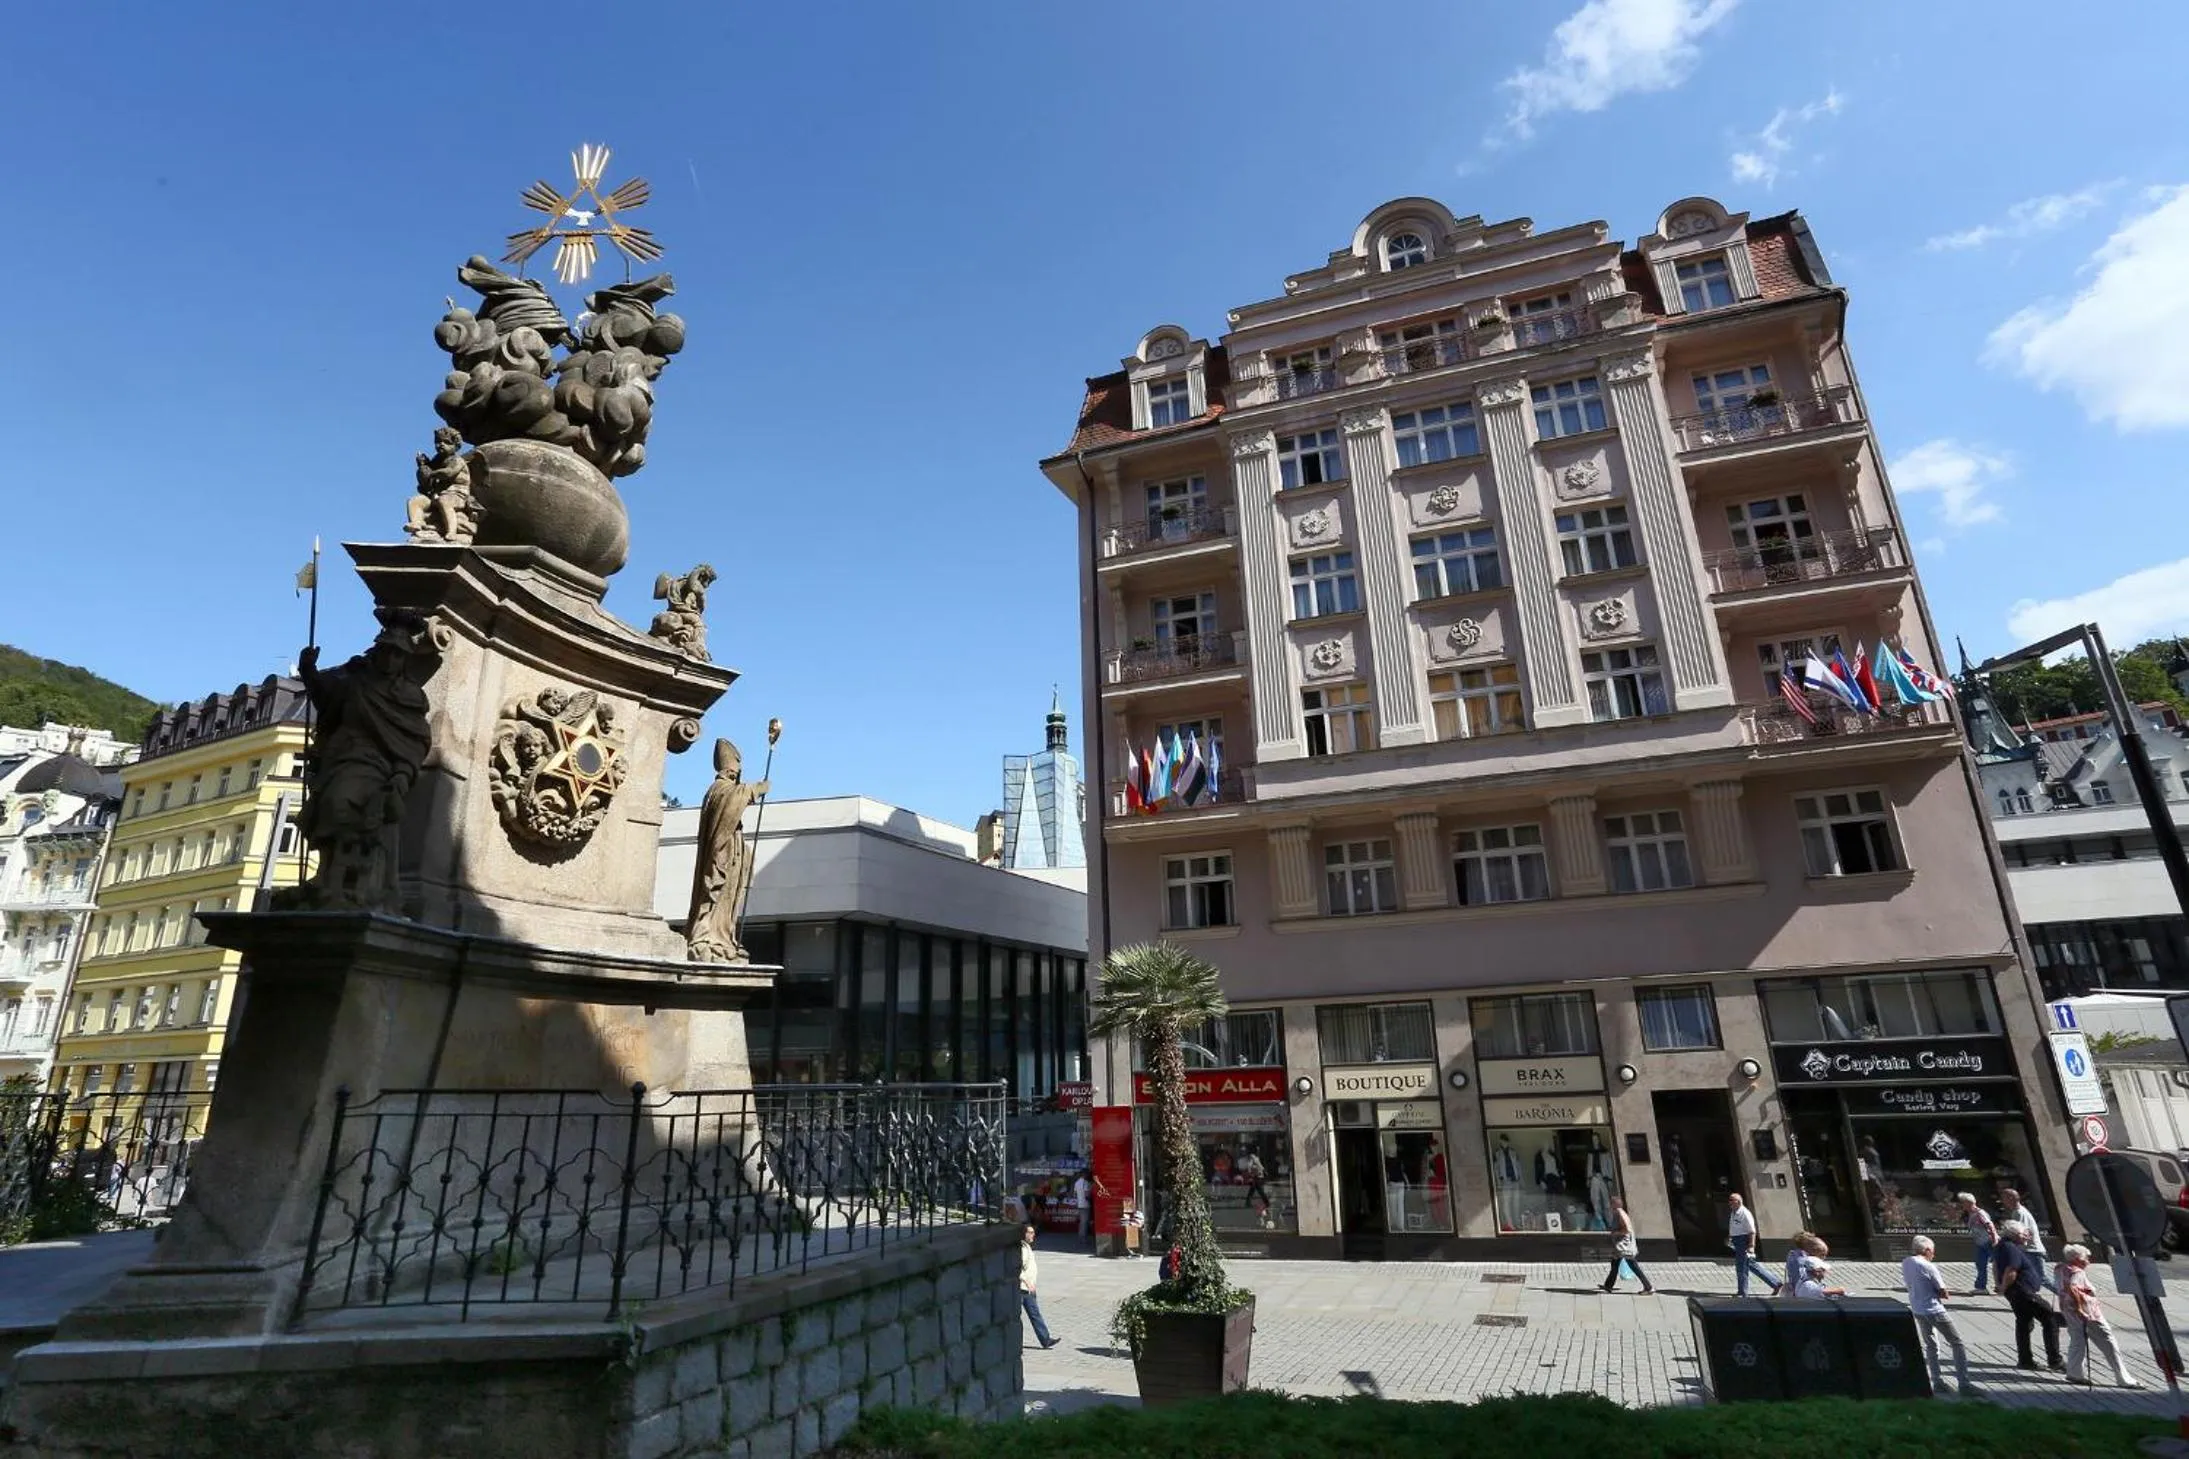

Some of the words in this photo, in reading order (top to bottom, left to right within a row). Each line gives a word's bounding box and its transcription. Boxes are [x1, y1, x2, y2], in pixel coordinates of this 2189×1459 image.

[1834, 1053, 1911, 1076] Captain
[1917, 1051, 1983, 1072] Candy
[1516, 1068, 1565, 1081] BRAX
[1220, 1078, 1278, 1093] ALLA
[1336, 1075, 1427, 1091] BOUTIQUE
[1881, 1089, 1934, 1106] Candy
